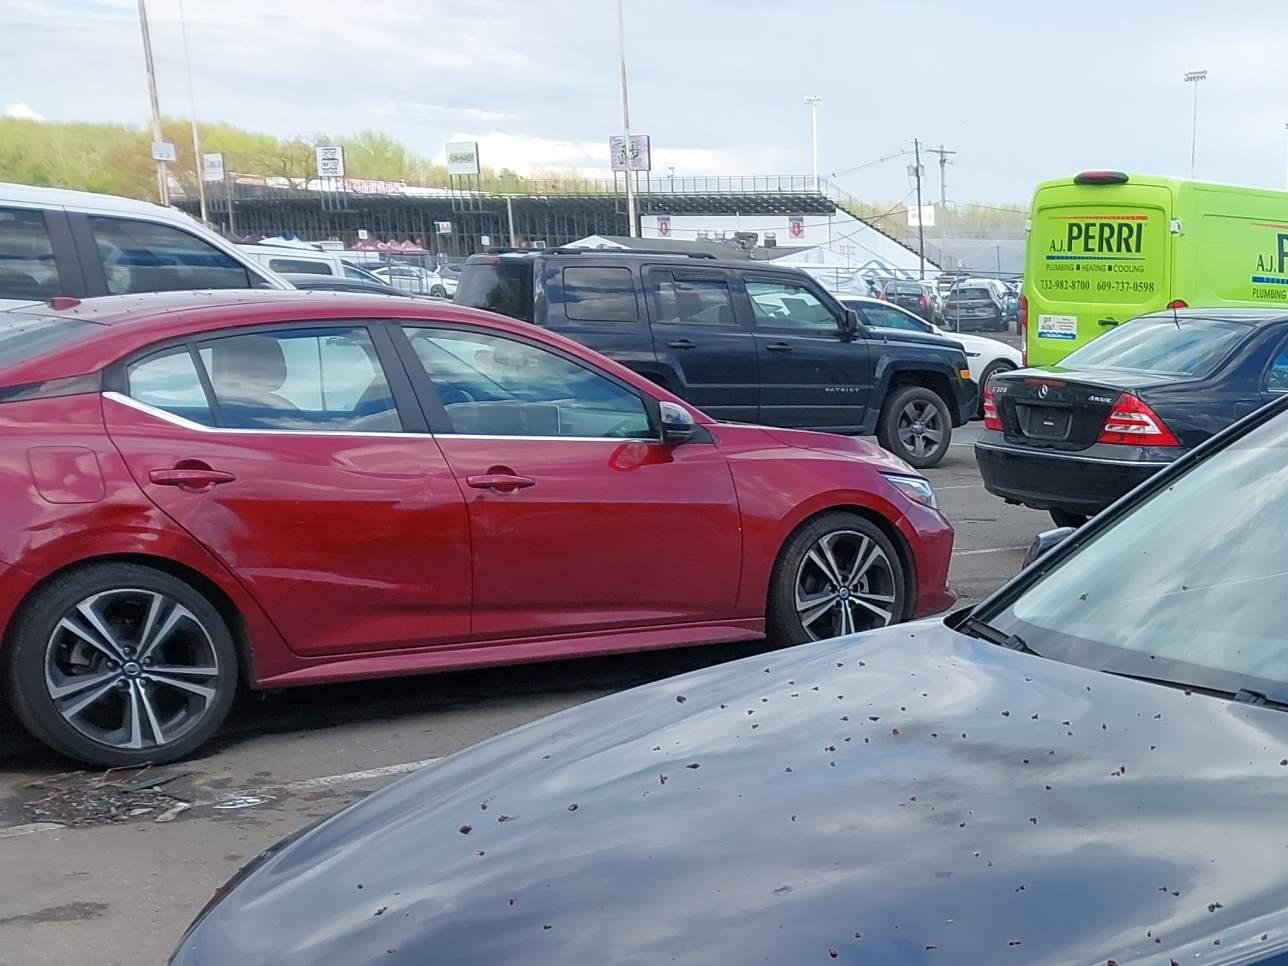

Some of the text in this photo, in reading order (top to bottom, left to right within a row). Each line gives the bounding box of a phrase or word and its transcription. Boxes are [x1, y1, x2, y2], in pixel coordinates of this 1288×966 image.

[1049, 223, 1143, 253] A.J. PERRI
[1046, 263, 1145, 273] PLUMBING HEATING COOLING
[1256, 254, 1276, 273] A.J.
[1040, 280, 1155, 292] 732-982-8700 609-737-0598
[1252, 288, 1287, 300] PLUMBING
